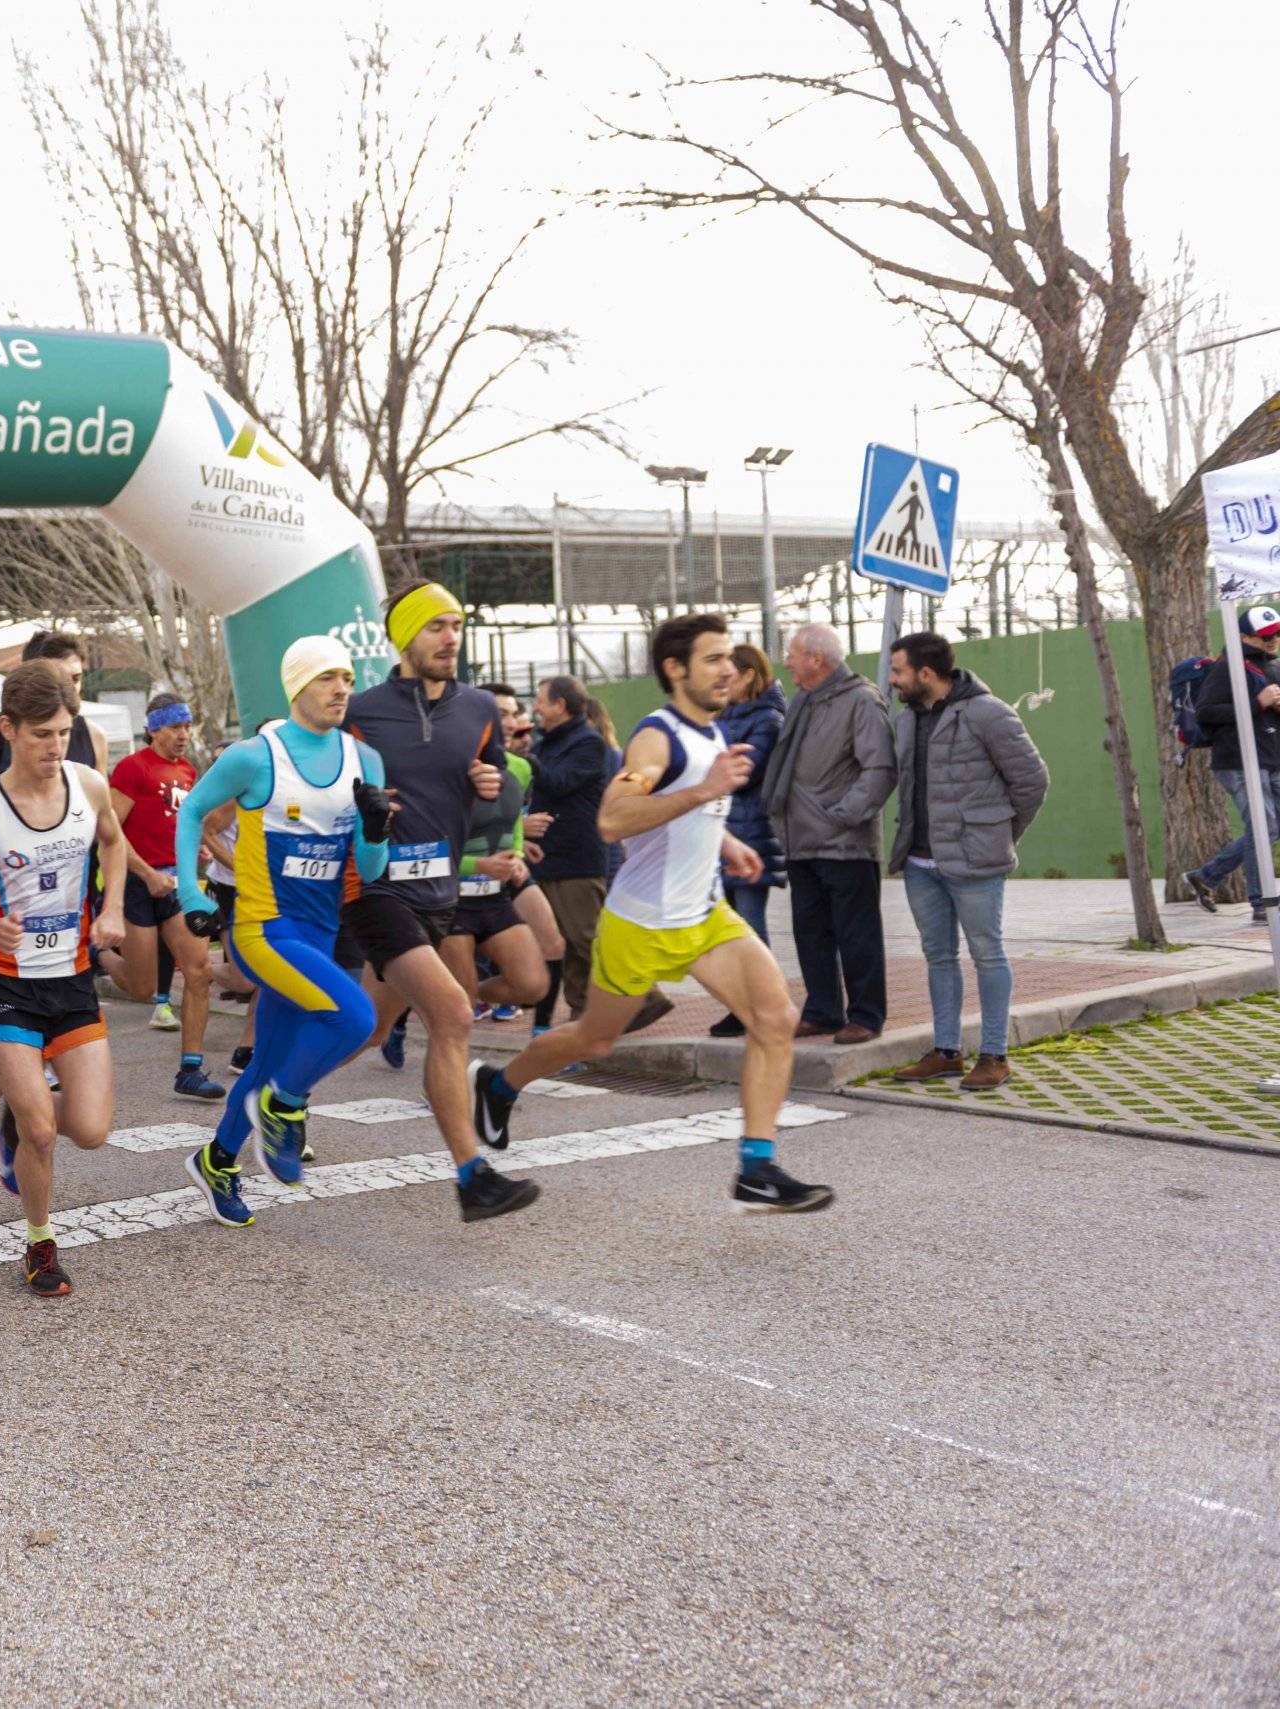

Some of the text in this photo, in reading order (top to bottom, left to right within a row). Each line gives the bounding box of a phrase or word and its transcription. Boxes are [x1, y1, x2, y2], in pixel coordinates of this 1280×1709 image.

[200, 464, 304, 502] Villanueva
[191, 494, 305, 526] de la Cañada
[34, 836, 86, 856] TRIATLÓN
[300, 860, 329, 878] 101
[408, 860, 431, 877] 47
[35, 932, 58, 949] 90
